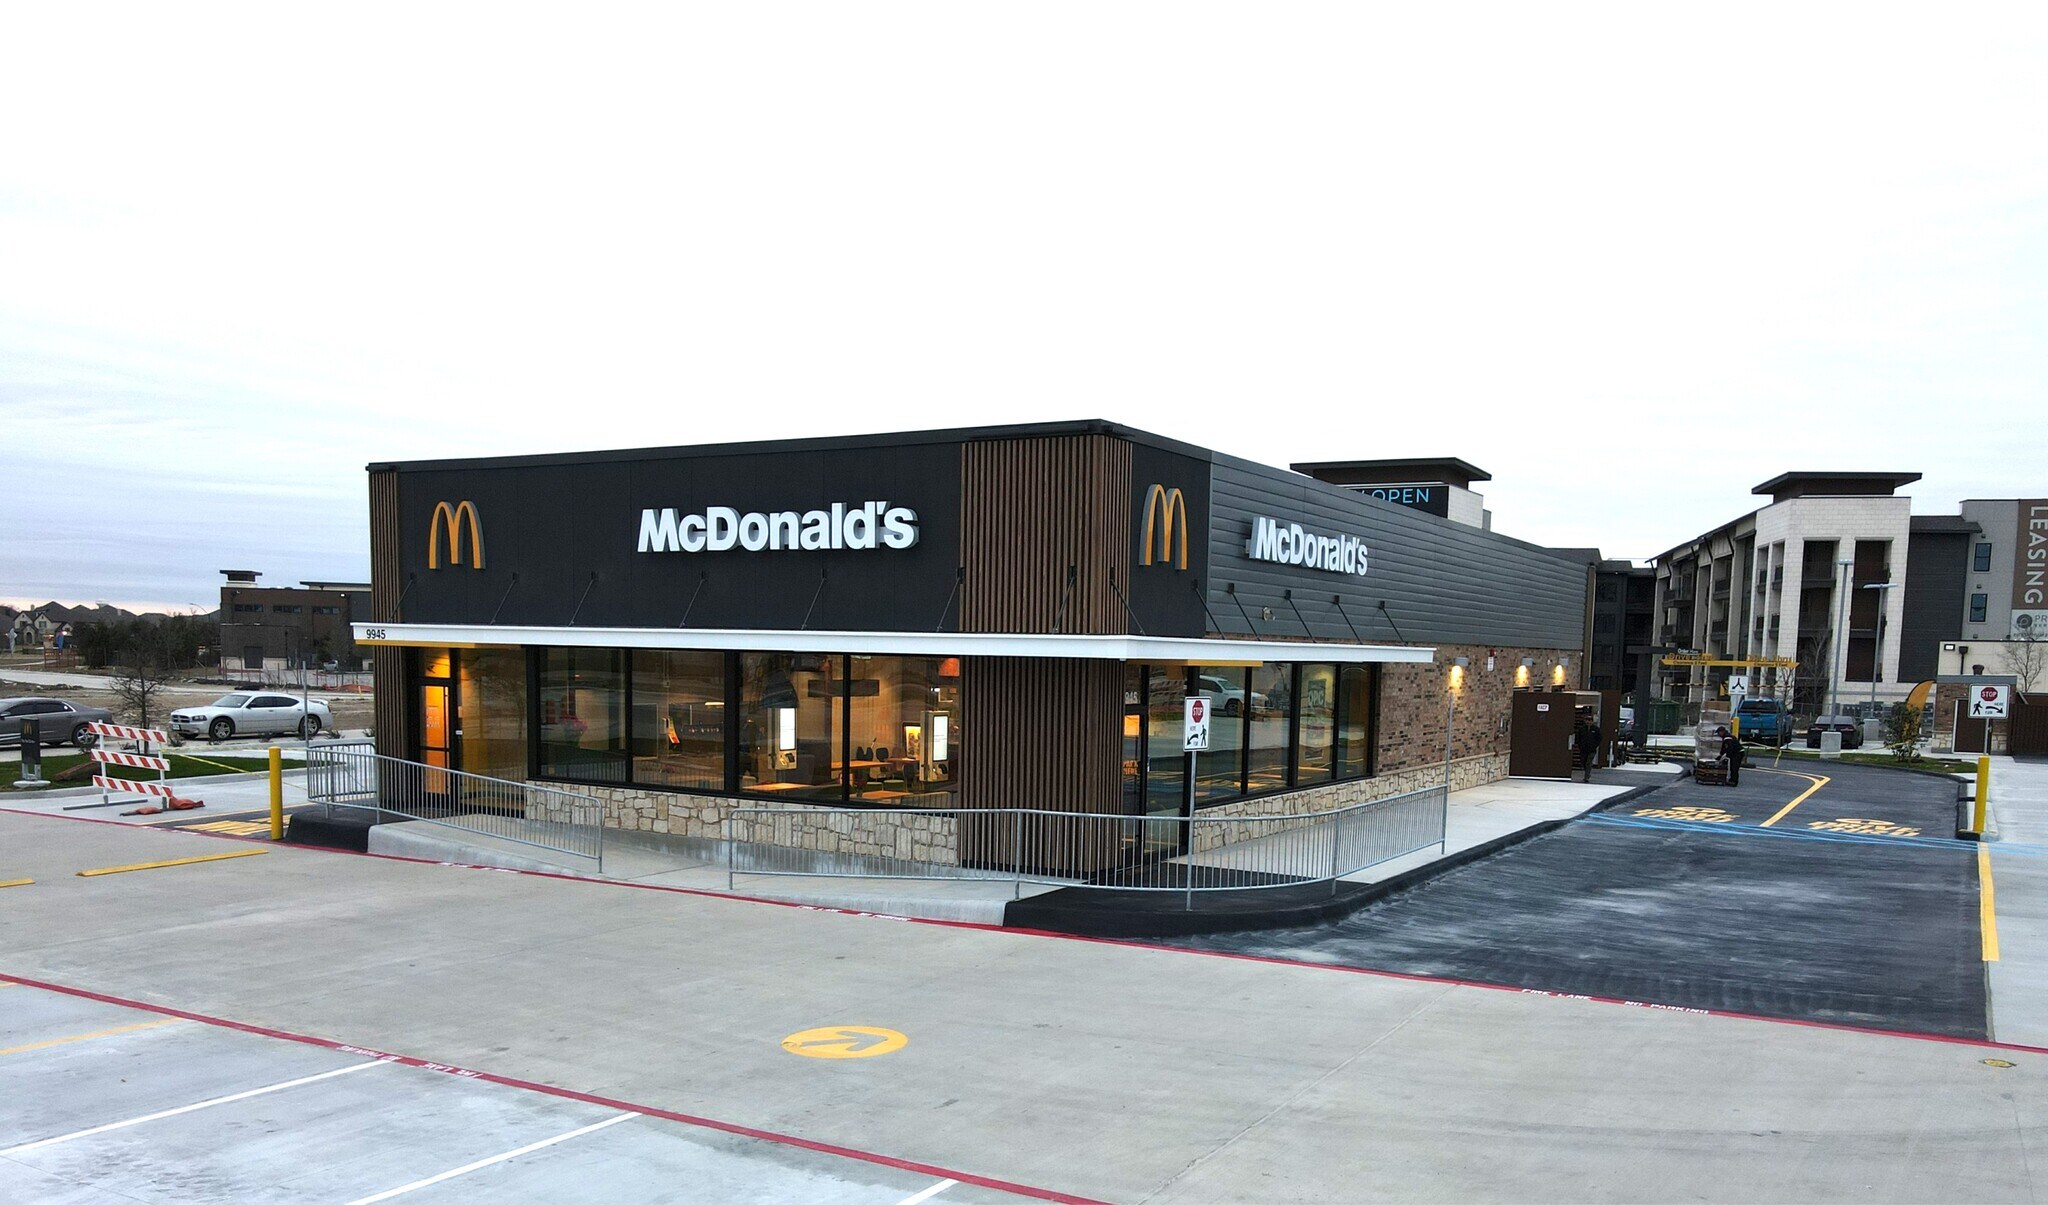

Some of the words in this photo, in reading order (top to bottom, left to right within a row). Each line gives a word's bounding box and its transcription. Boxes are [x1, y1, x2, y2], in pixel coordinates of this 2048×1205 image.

[637, 501, 918, 552] McDonald's
[1252, 516, 1368, 576] McDonald's
[2024, 506, 2048, 604] LEASING
[366, 629, 386, 639] 9945
[1193, 706, 1203, 716] STOP
[1522, 988, 1551, 996] FIRE
